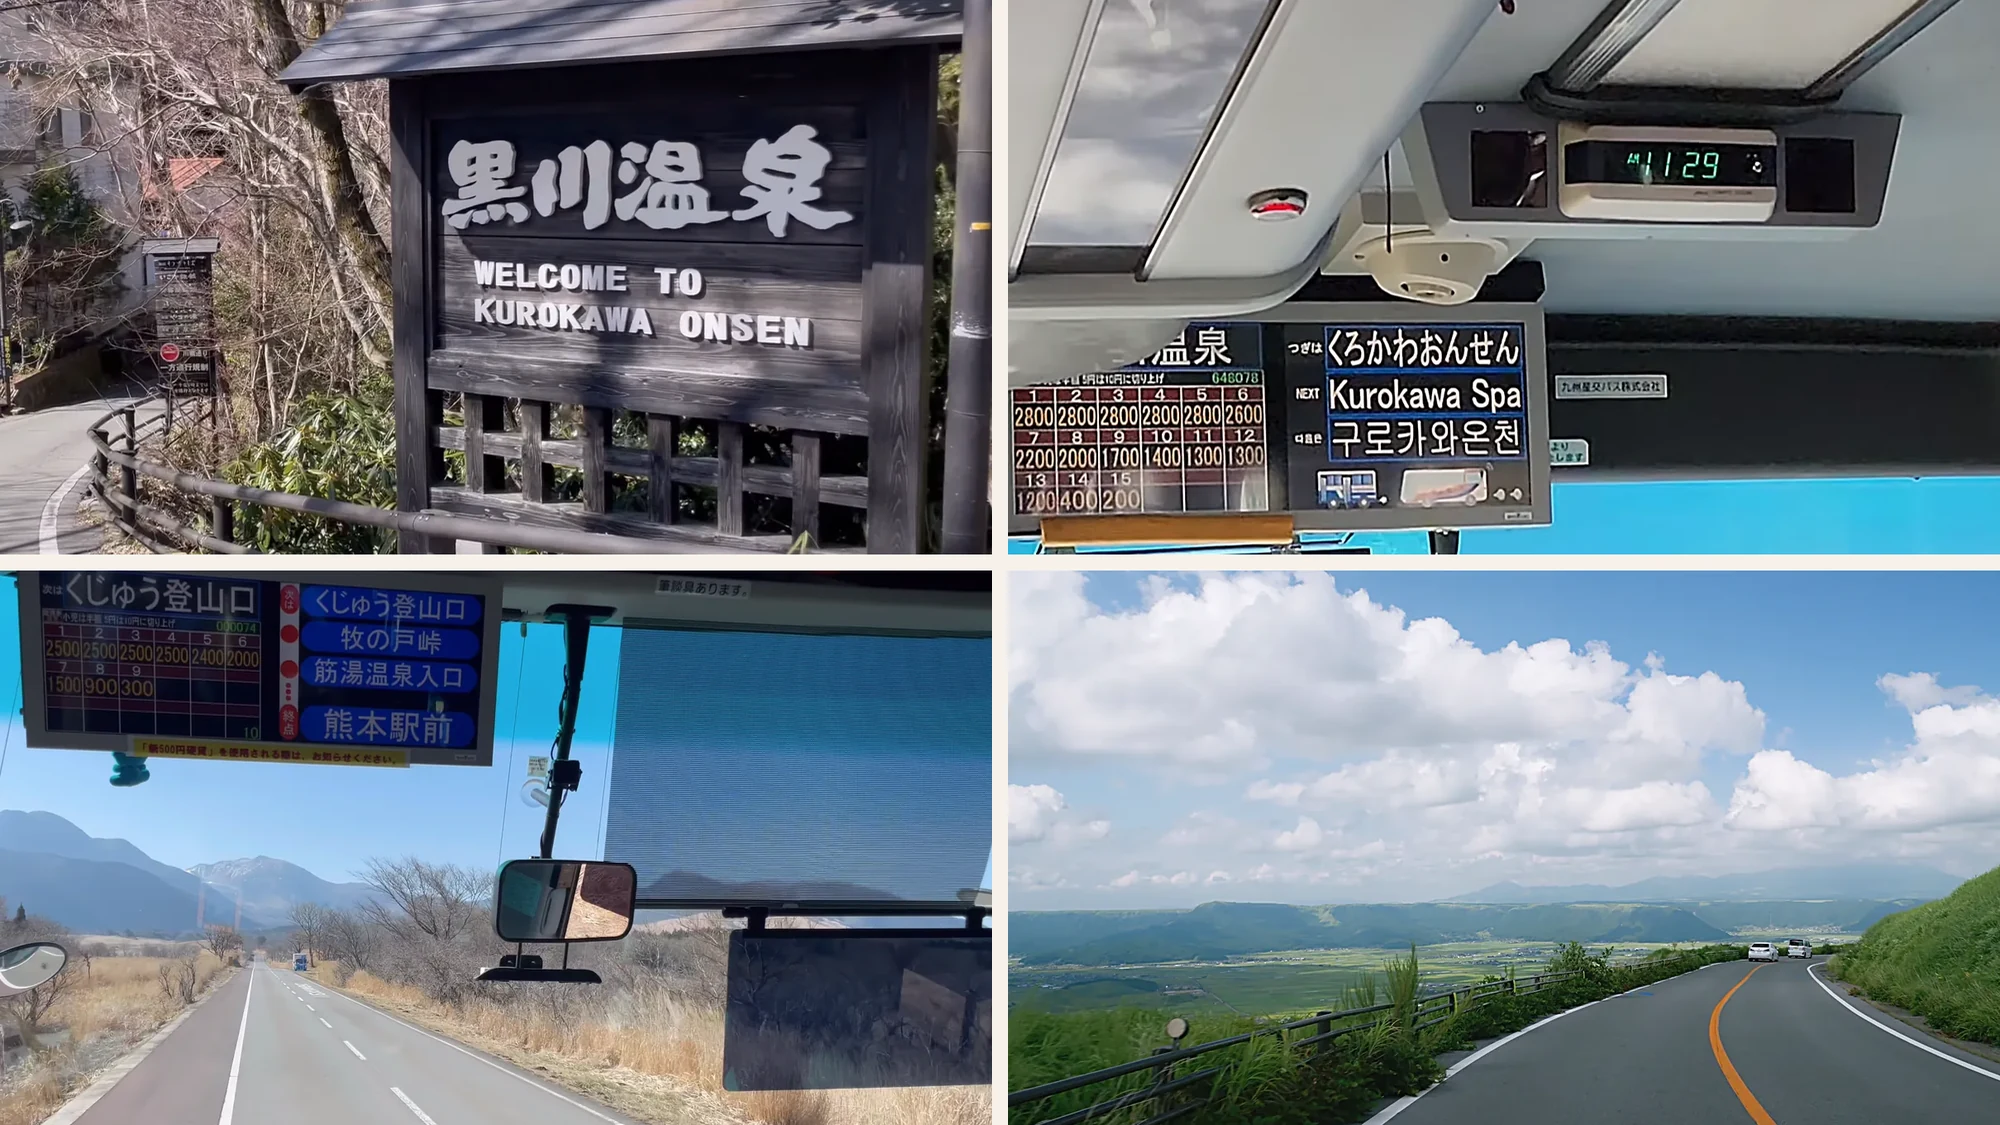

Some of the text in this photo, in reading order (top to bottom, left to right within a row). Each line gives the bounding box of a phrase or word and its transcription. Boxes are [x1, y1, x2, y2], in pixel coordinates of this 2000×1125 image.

[441, 124, 854, 238] 黒川温泉
[474, 260, 705, 297] WELCOME TO
[474, 298, 811, 348] KUROKAWA ONSEN
[1139, 326, 1232, 366] 温泉
[1288, 329, 1519, 366] つぎは くろかわおんせん
[1211, 372, 1259, 384] 648078
[1029, 388, 1249, 402] 1 2 3 4 5 6
[1296, 378, 1522, 414] NEXT Kurokawa Spa
[1015, 404, 1262, 427] 2800 2800 2800 2800 2800 2600
[1029, 430, 1255, 444] 7 8 9 10 11 12
[1333, 420, 1520, 457] 구로카와온천
[1016, 446, 1264, 469] 2200 2000 1700 1400 1300 1300
[1026, 473, 1131, 487] 13 14 15
[1018, 489, 1140, 511] 1200 400 200
[42, 573, 254, 614] 次は くじゅう登山口
[284, 590, 295, 610] 次は
[316, 588, 466, 621] くじゅう登山口
[58, 627, 247, 647] 1 2 3 4 5 6
[216, 622, 257, 633] 000074
[341, 625, 442, 655] 牧の戸峠
[46, 640, 259, 667] 2500 2500 2500 2500 2400 2000
[59, 662, 141, 677] 7 8 9
[314, 658, 463, 688] 筋湯温泉入口
[49, 676, 154, 697] 1500 900 300
[244, 727, 259, 739] 10
[283, 710, 295, 736] 終点
[324, 708, 453, 744] 熊本駅前
